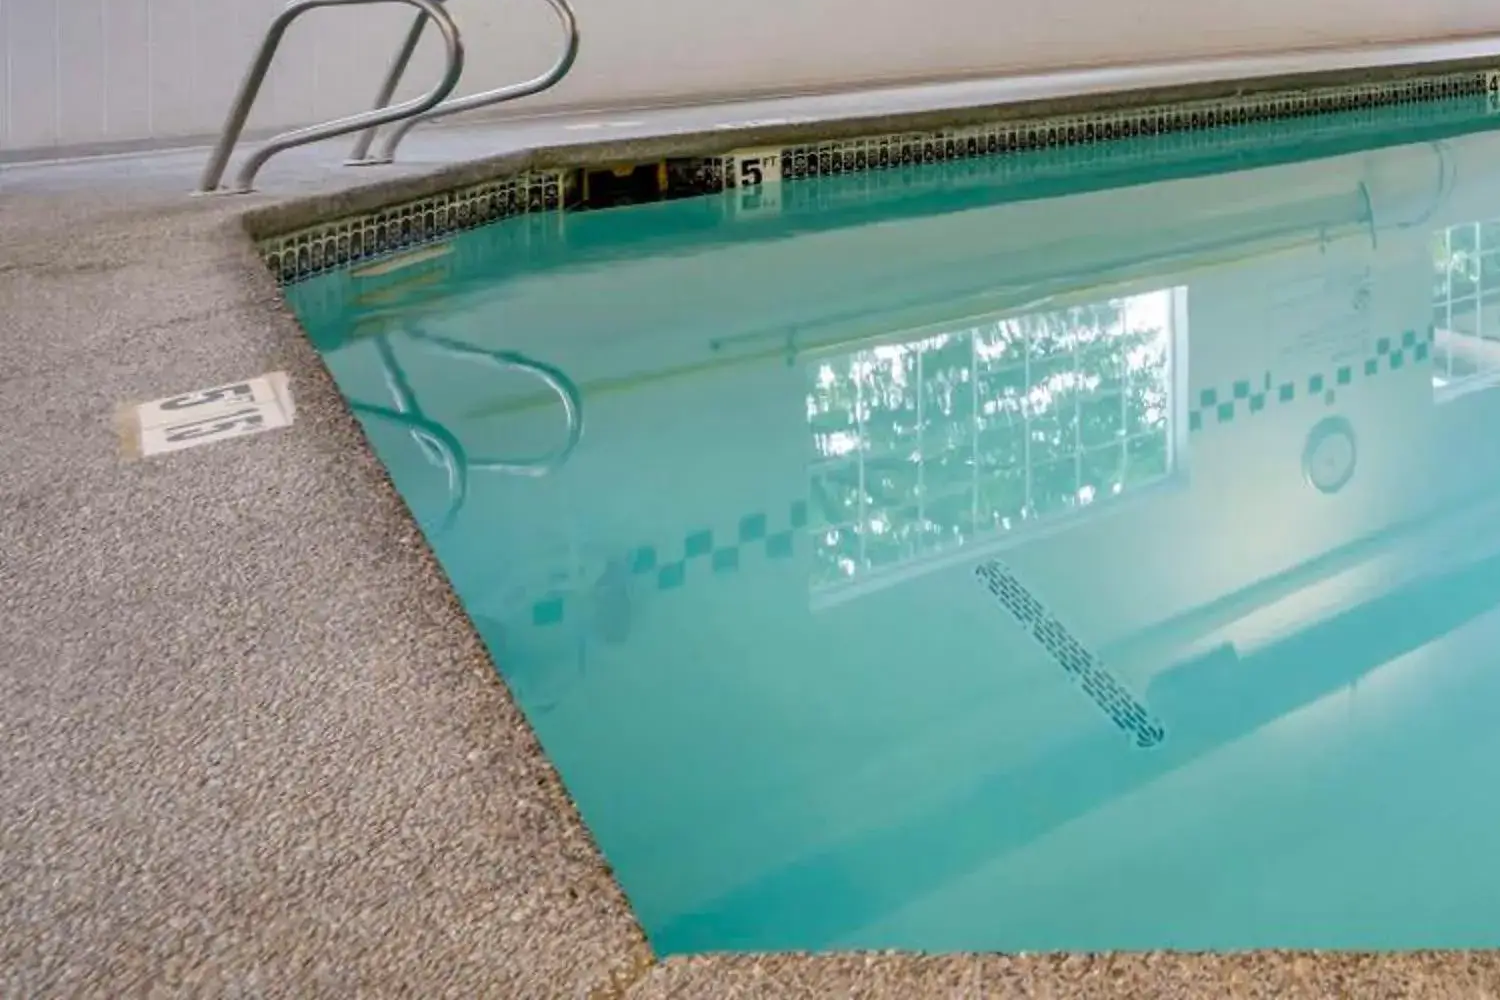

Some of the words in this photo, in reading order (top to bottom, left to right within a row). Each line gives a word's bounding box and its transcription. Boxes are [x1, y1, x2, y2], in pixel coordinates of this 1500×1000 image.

[1489, 75, 1498, 91] 4
[741, 159, 763, 186] 5
[160, 384, 251, 410] 5
